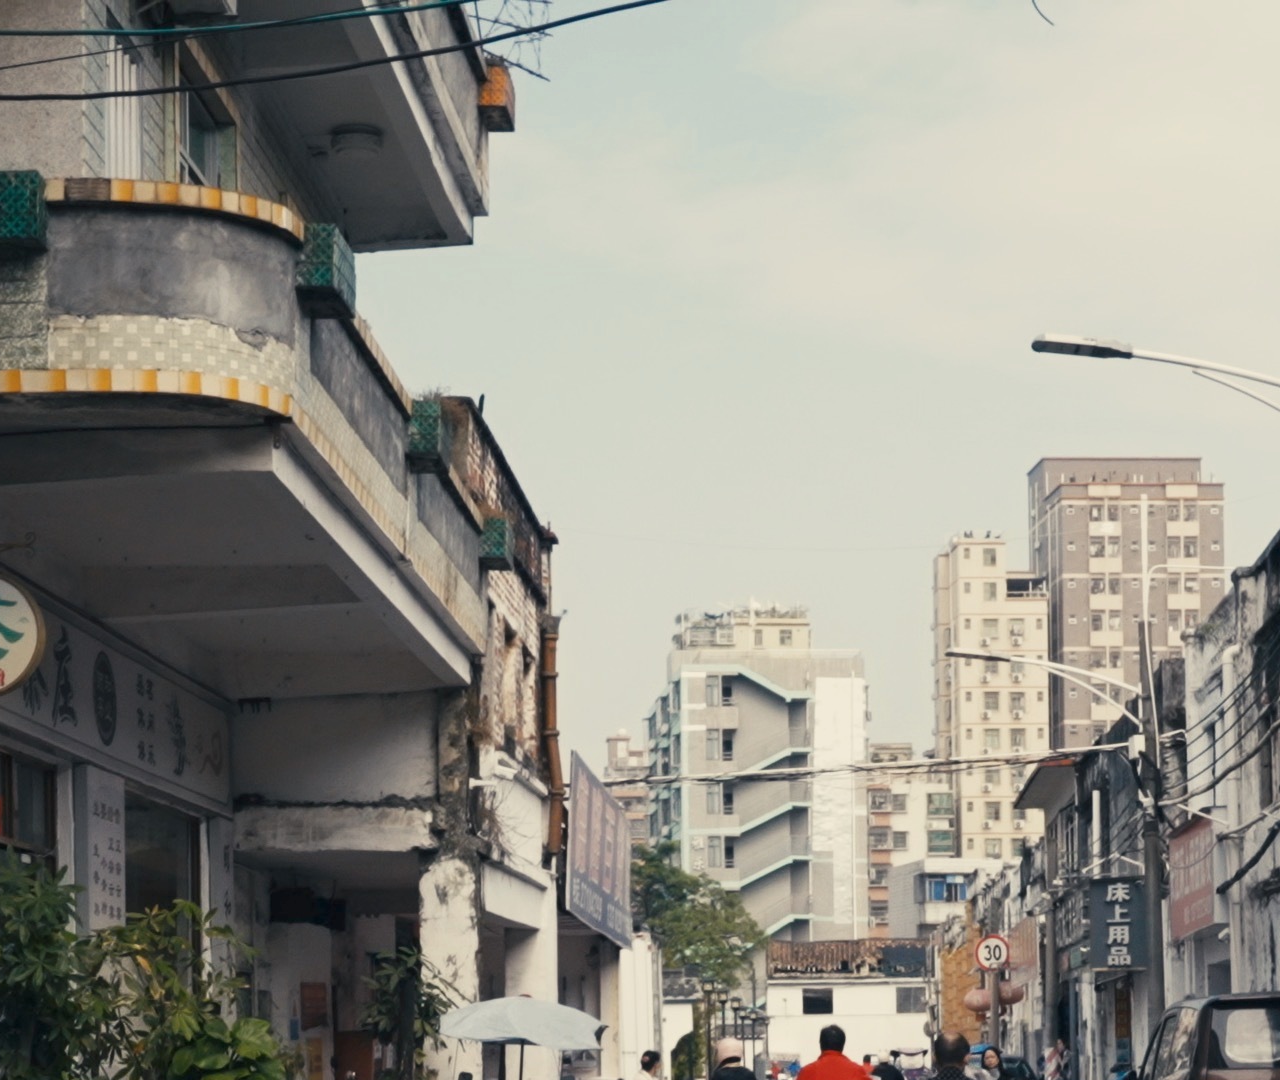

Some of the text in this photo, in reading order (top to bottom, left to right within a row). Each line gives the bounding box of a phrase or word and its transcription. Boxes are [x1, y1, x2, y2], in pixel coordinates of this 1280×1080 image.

[1105, 882, 1132, 966] 床上用品
[984, 945, 1002, 961] 30
